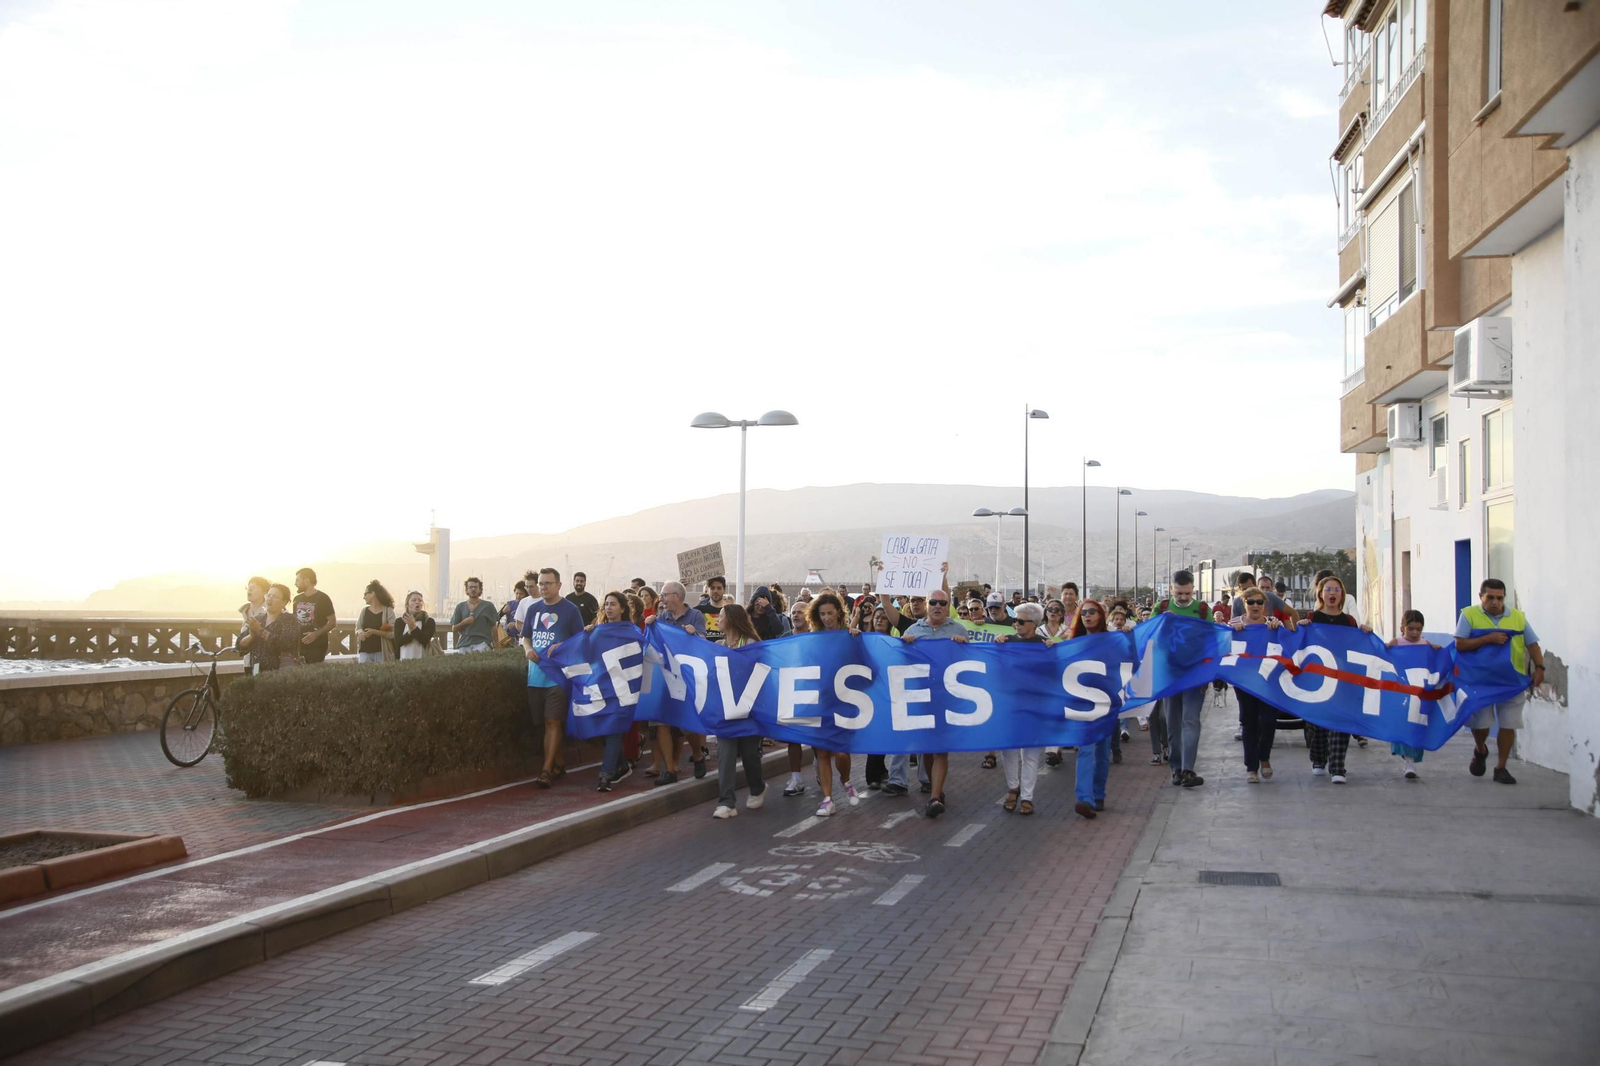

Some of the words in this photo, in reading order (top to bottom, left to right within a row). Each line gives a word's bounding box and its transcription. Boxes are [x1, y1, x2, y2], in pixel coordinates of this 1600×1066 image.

[886, 536, 910, 554] CABO
[916, 537, 939, 555] GATA
[685, 550, 700, 561] PLAYA
[902, 555, 918, 569] NO
[681, 569, 692, 578] NO
[884, 571, 897, 588] SE
[967, 629, 995, 642] ecin
